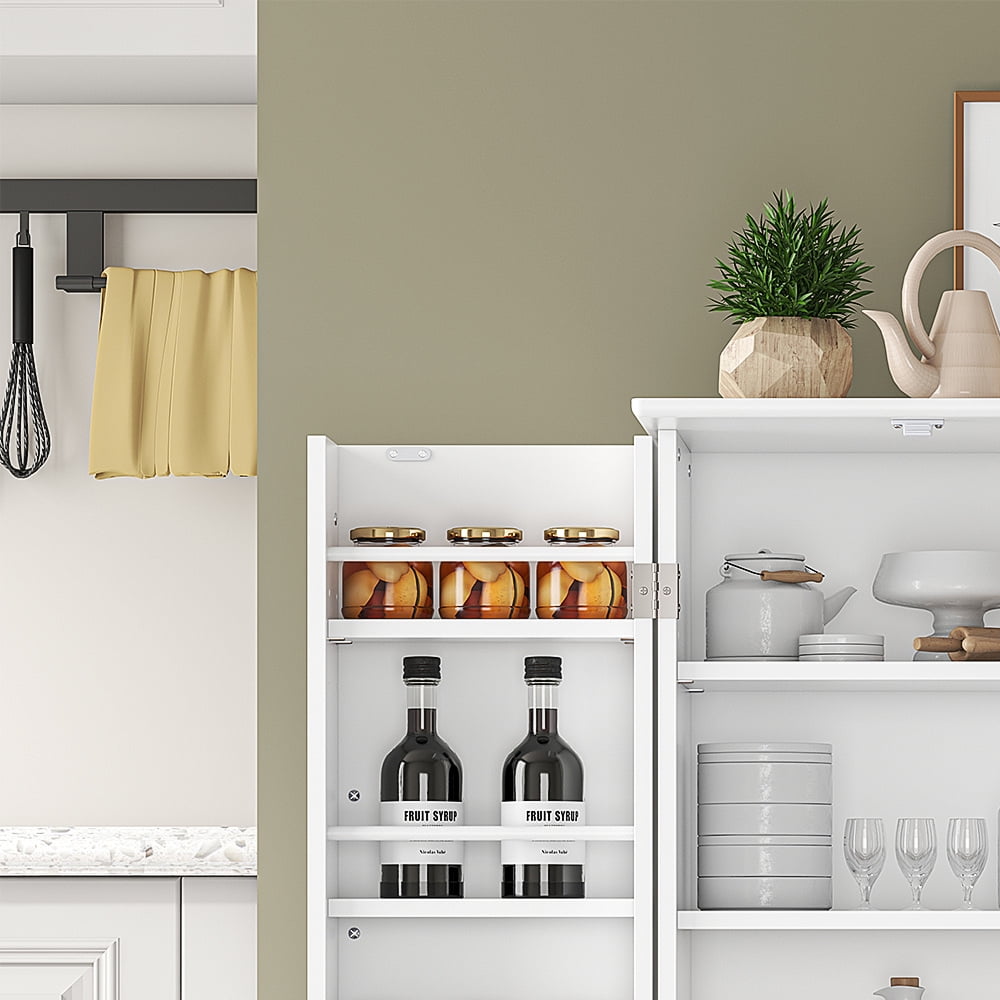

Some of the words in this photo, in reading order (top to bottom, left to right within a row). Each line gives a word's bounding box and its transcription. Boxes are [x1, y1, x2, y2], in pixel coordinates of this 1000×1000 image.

[404, 810, 430, 821] FRUIT
[433, 810, 458, 821] SYRUP
[526, 810, 552, 821] FRUIT
[555, 810, 579, 821] SYRUP
